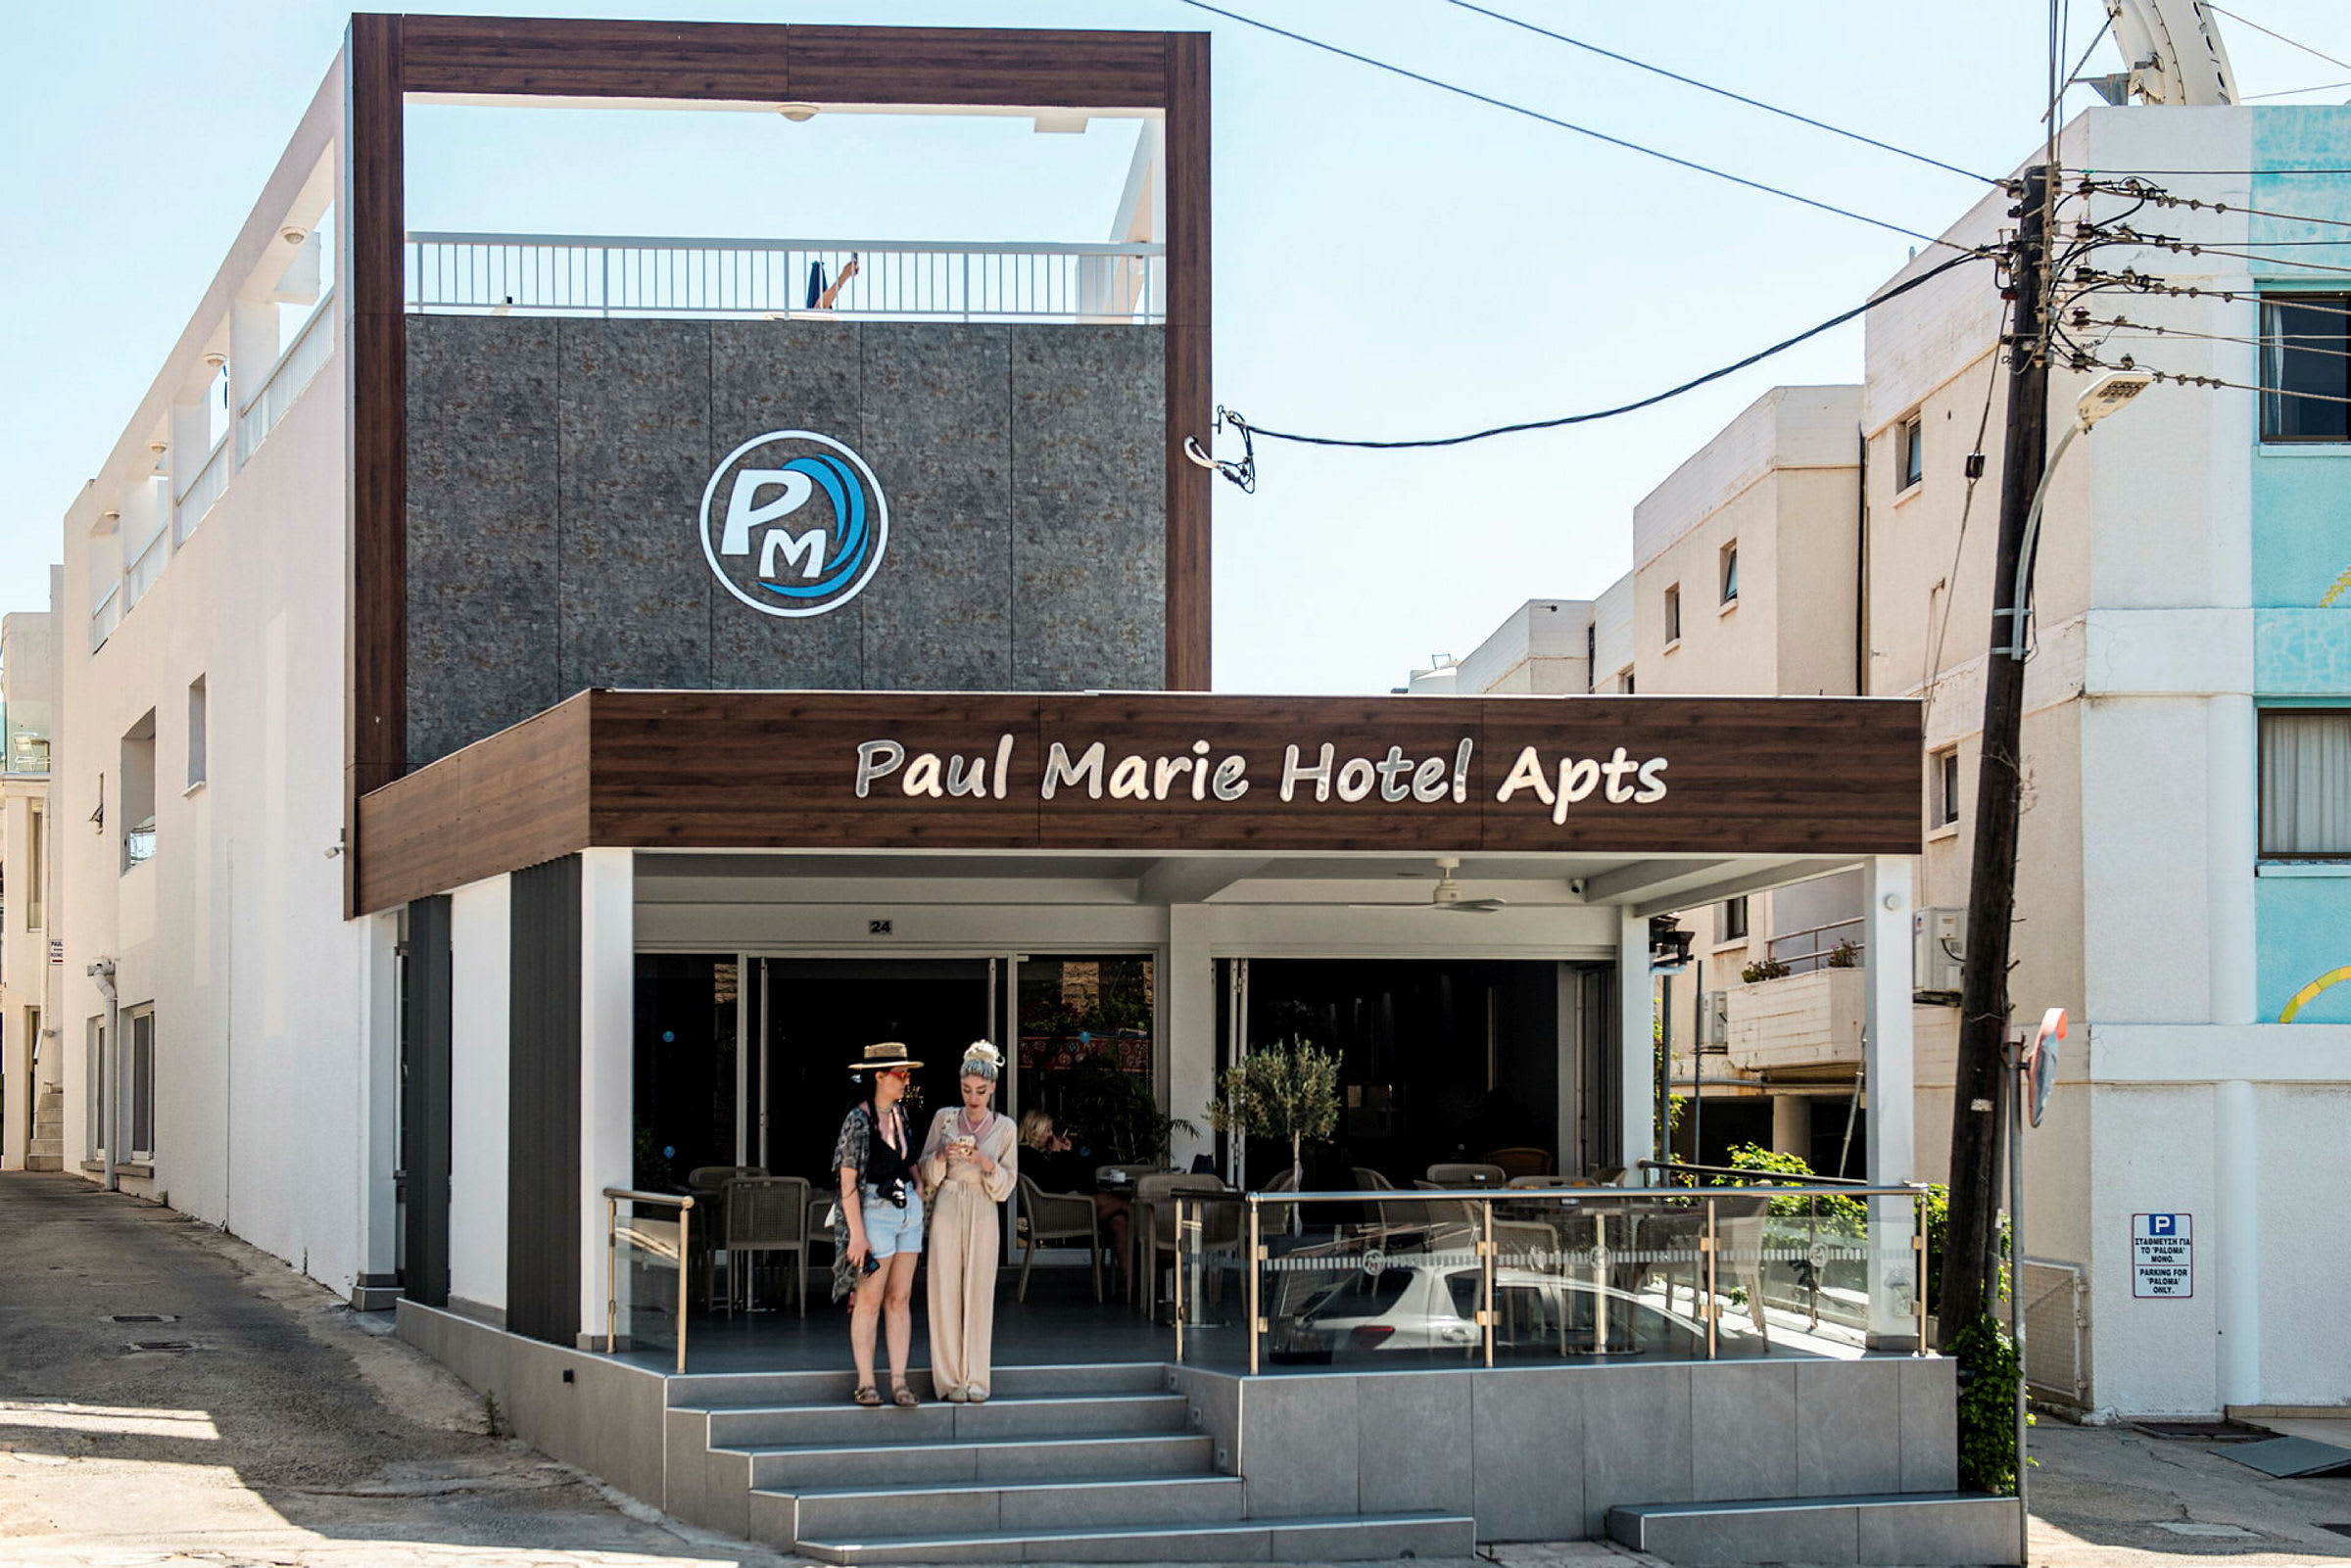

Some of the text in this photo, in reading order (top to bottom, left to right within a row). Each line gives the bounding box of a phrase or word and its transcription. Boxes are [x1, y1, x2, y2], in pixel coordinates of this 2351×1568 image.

[855, 734, 1668, 826] Paul Marie Hotel Apts
[871, 921, 890, 932] 24
[2155, 1215, 2170, 1233] P
